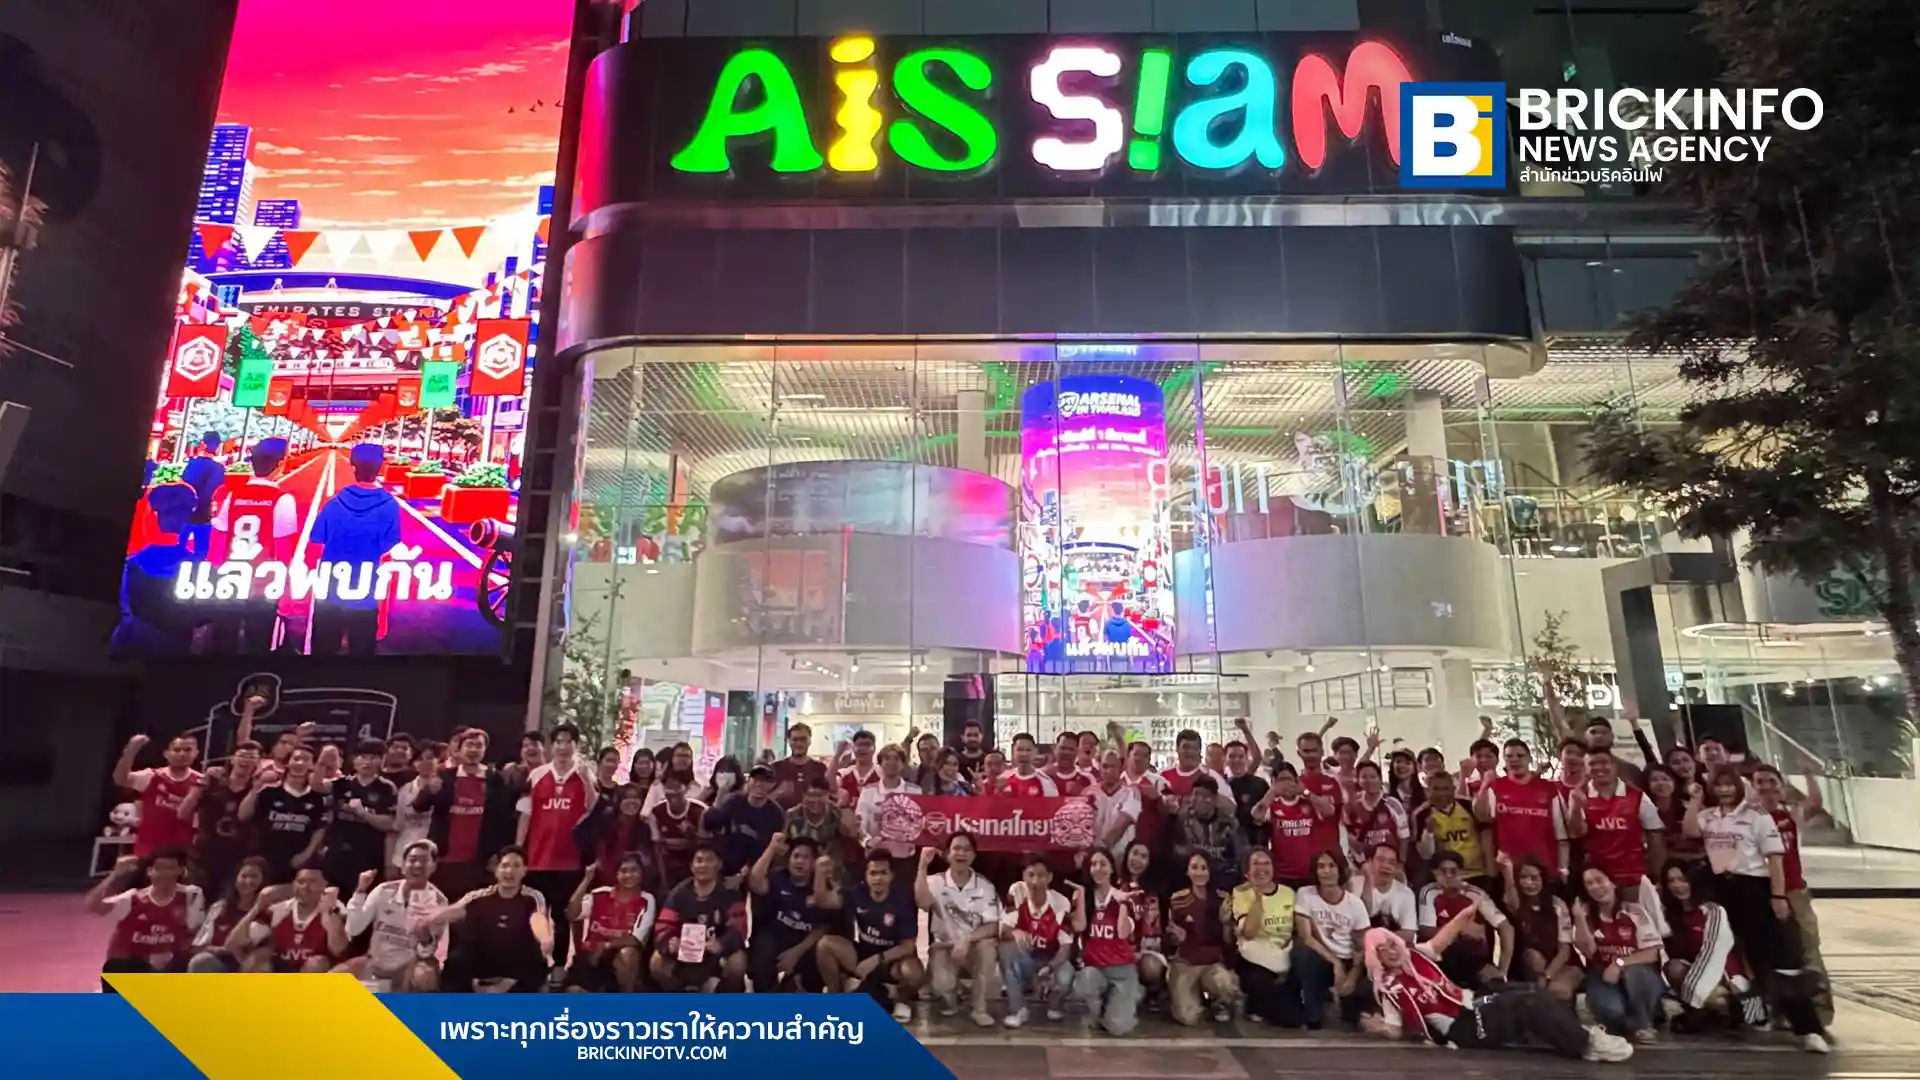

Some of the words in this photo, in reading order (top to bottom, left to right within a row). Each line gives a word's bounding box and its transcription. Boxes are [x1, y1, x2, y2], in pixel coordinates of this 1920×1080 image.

[174, 542, 454, 601] แล้วพบกัน
[541, 797, 572, 810] JVC
[1595, 816, 1628, 831] JVC
[1442, 829, 1468, 843] JVC
[1089, 923, 1114, 939] JVC
[1029, 934, 1048, 949] VC
[280, 948, 314, 961] JVC
